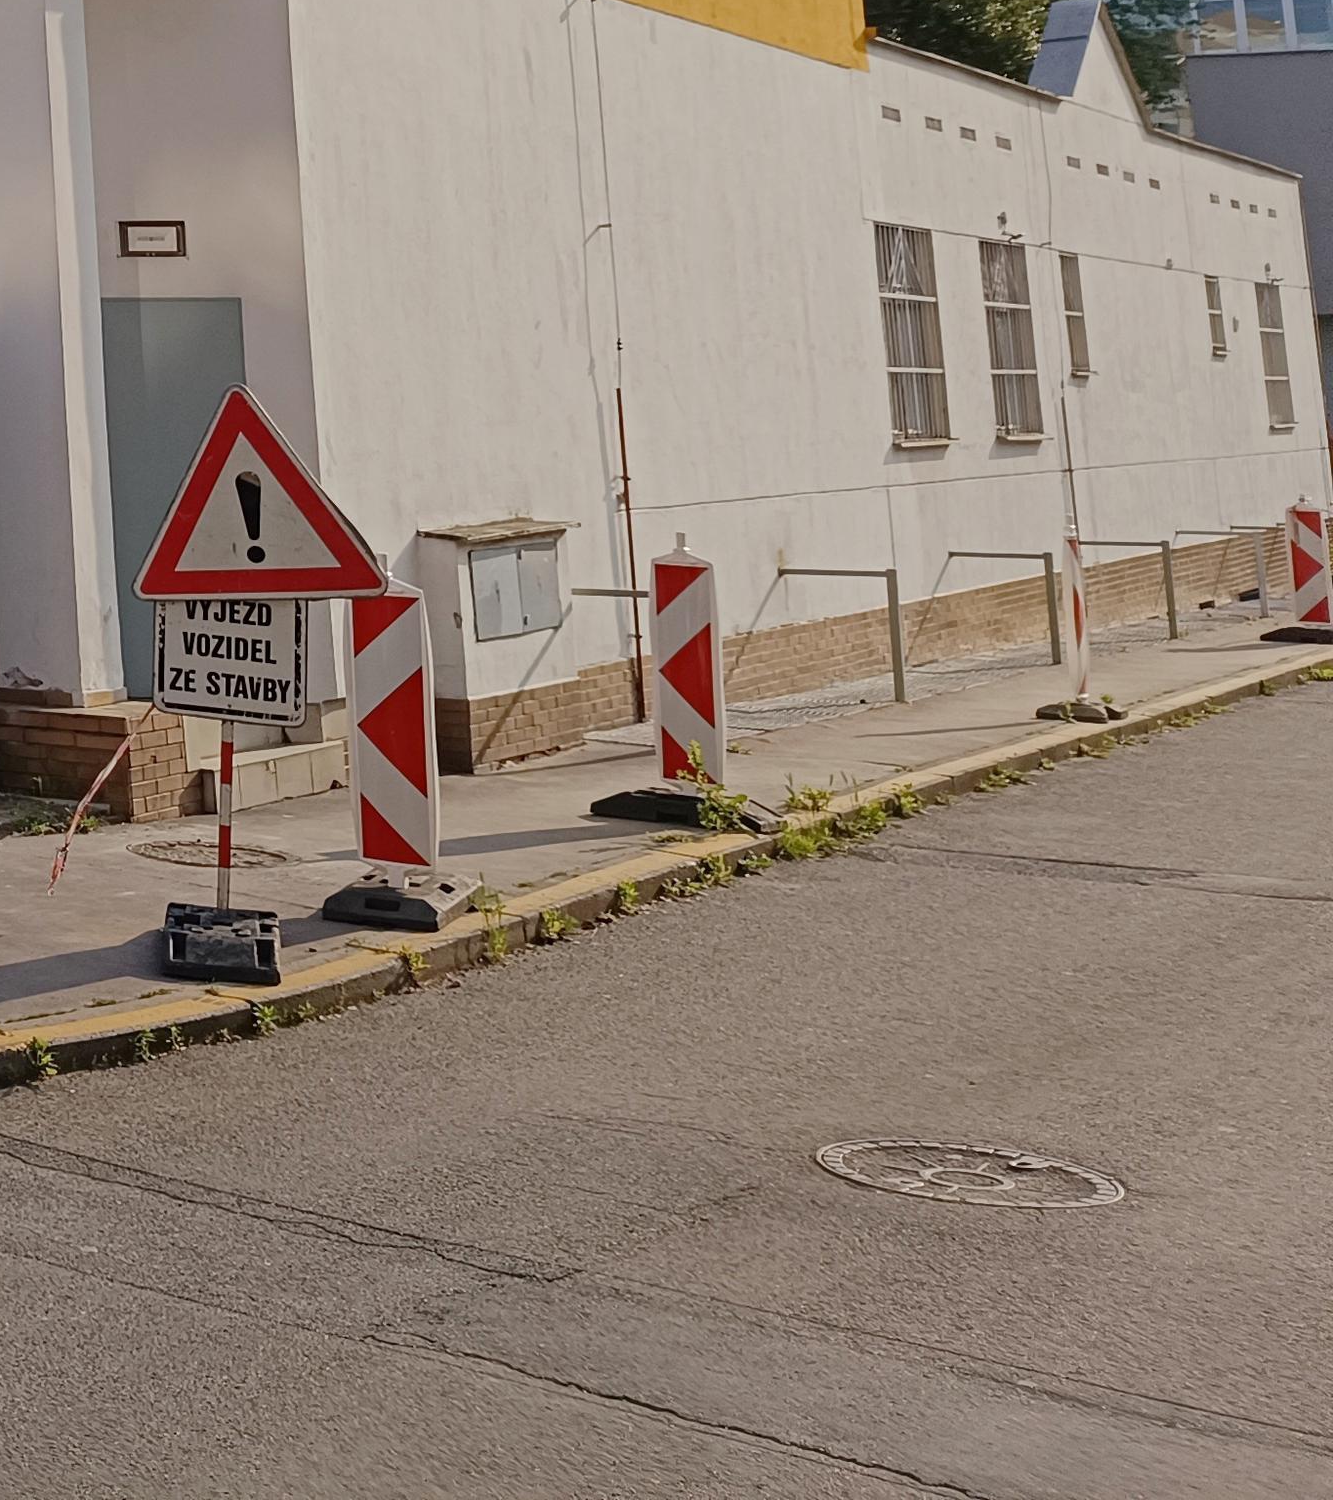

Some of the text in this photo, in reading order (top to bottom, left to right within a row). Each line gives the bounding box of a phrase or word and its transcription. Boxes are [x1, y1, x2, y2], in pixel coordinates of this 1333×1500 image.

[182, 632, 277, 664] VOZIDEL
[169, 667, 291, 703] ZE STAVBY
